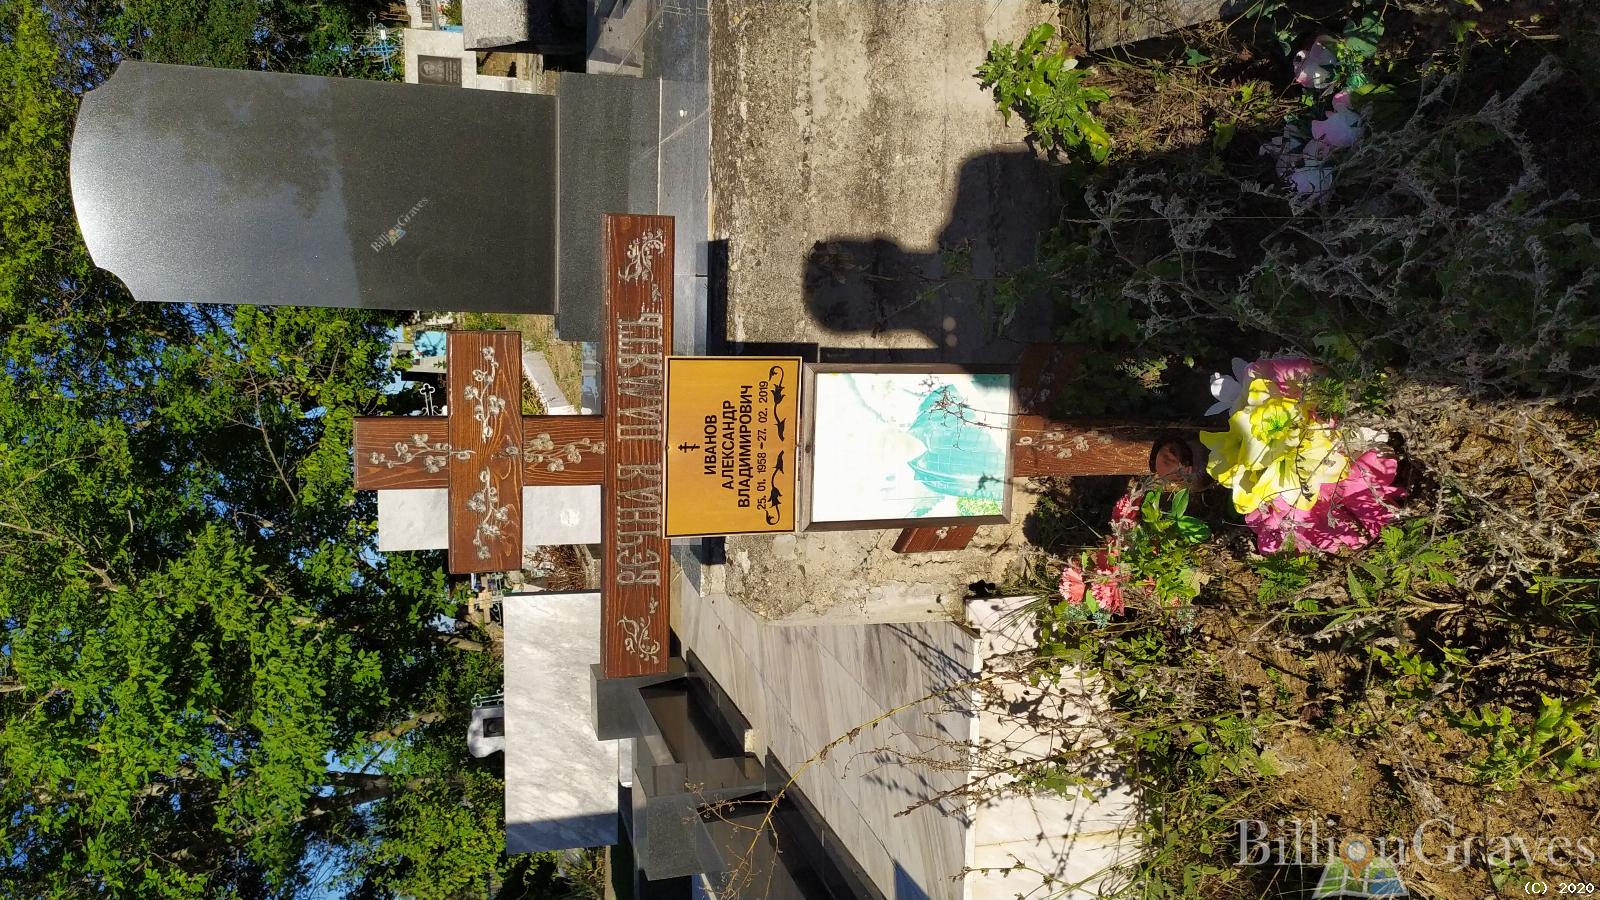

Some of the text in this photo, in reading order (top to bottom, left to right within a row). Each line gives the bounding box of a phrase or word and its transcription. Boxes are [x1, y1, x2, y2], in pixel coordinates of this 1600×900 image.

[758, 380, 769, 404] 2019
[758, 408, 768, 423] 02.
[616, 312, 663, 587] ВЕЧНАЯ ПАМЯТЬ
[703, 414, 718, 475] ИВАНОВ
[721, 400, 737, 490] АЛЕКСАНДР
[737, 385, 754, 508] ВЛАДИМИРОВИЧ
[758, 452, 767, 474] 1958
[757, 479, 767, 492] 01.
[757, 495, 767, 511] 25.
